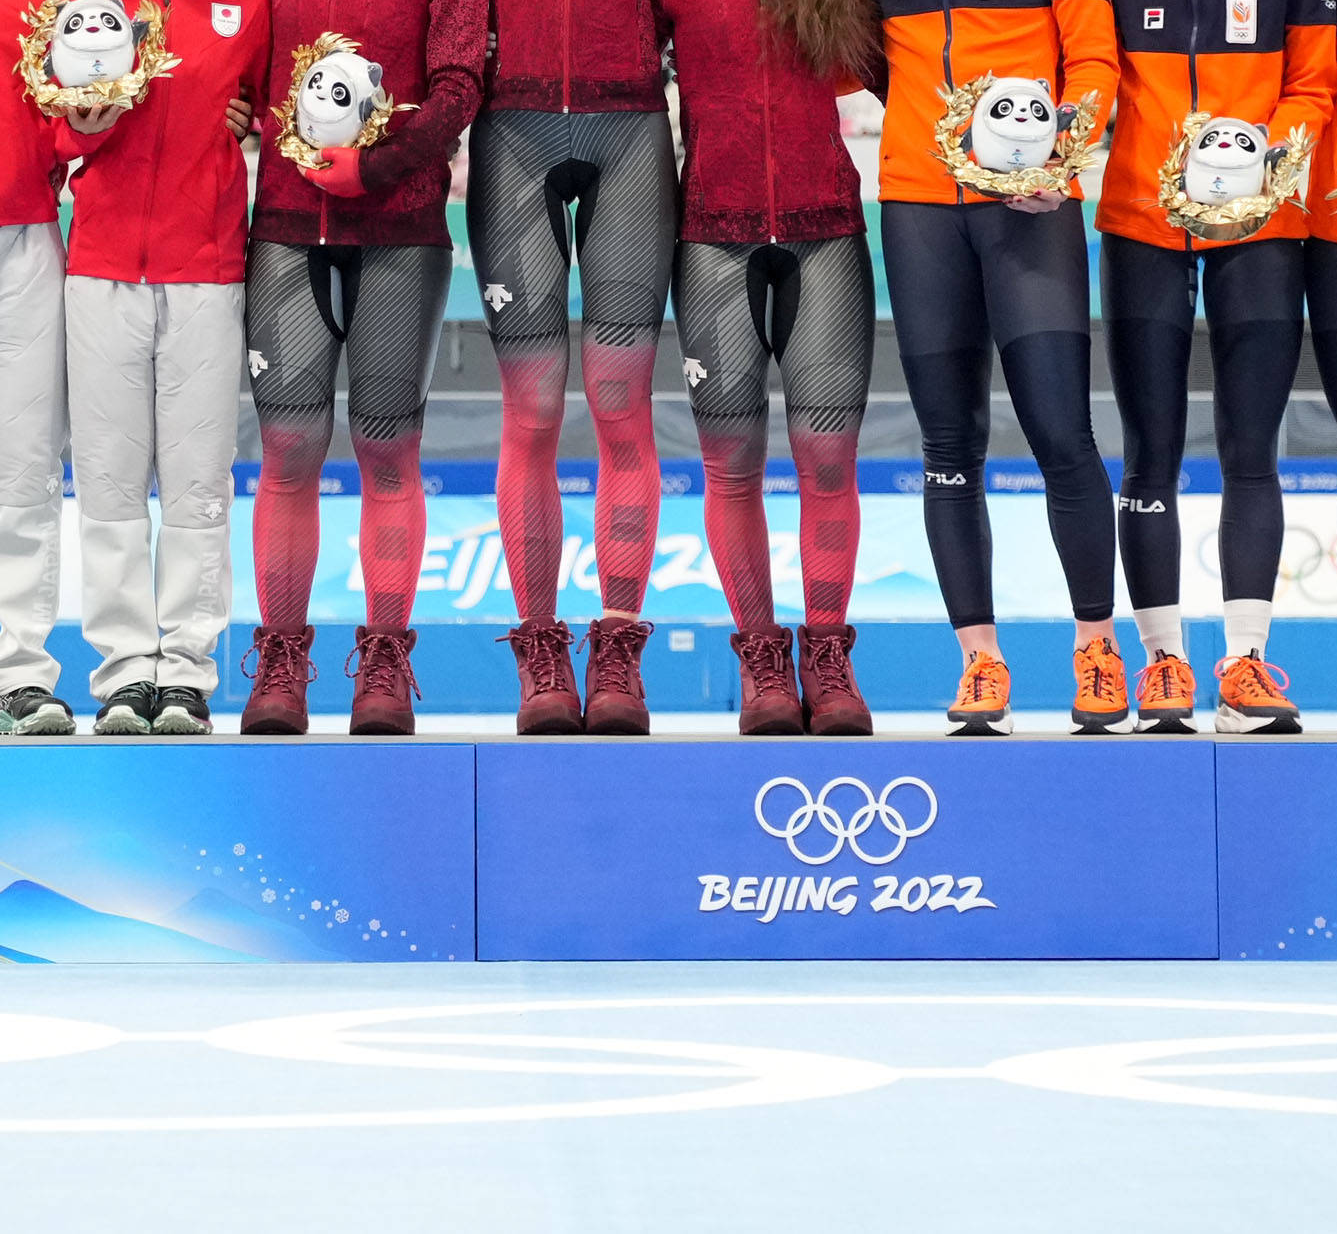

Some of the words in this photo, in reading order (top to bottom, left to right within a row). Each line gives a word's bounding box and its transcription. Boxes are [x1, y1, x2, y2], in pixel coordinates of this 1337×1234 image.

[925, 471, 966, 485] FILA
[1119, 496, 1166, 513] FILA
[697, 875, 859, 924] BEIJING
[870, 874, 998, 913] 2022
